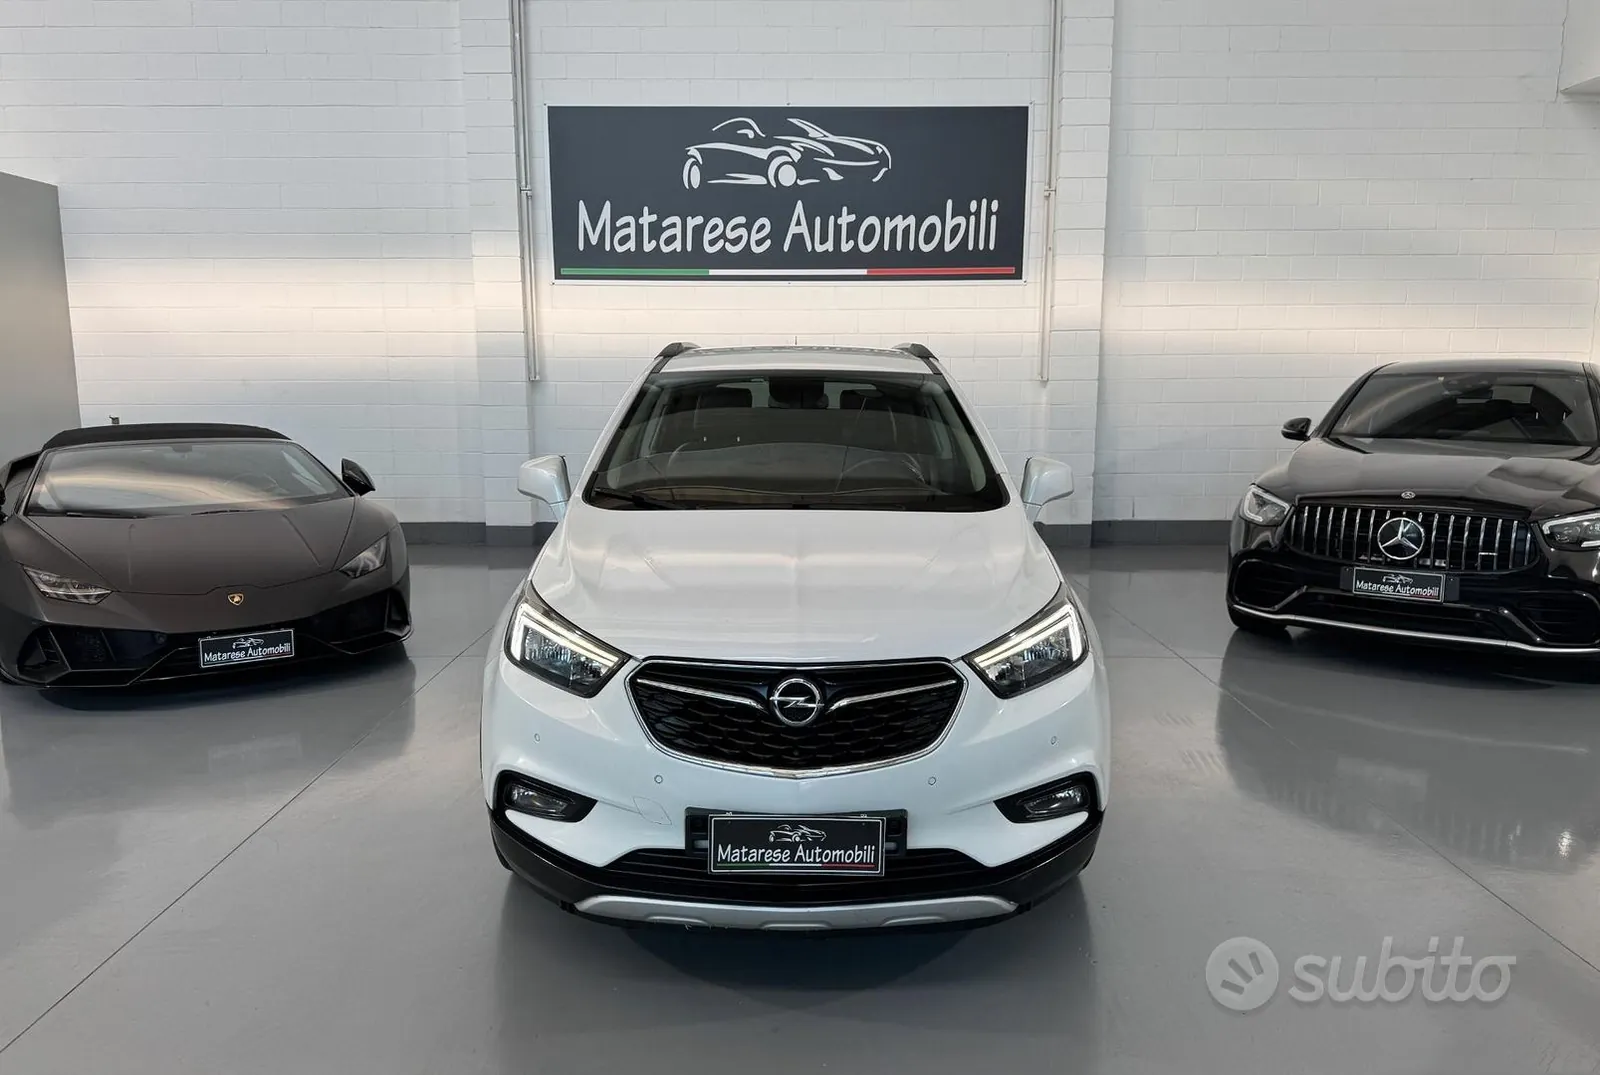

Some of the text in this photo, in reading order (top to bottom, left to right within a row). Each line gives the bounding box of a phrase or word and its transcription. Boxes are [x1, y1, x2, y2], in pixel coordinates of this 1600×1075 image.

[577, 197, 999, 254] Matarese Automobili
[1356, 580, 1440, 597] Matarese Automobili
[204, 643, 291, 662] Matarese Automobili
[717, 844, 876, 863] Matarese Automobili
